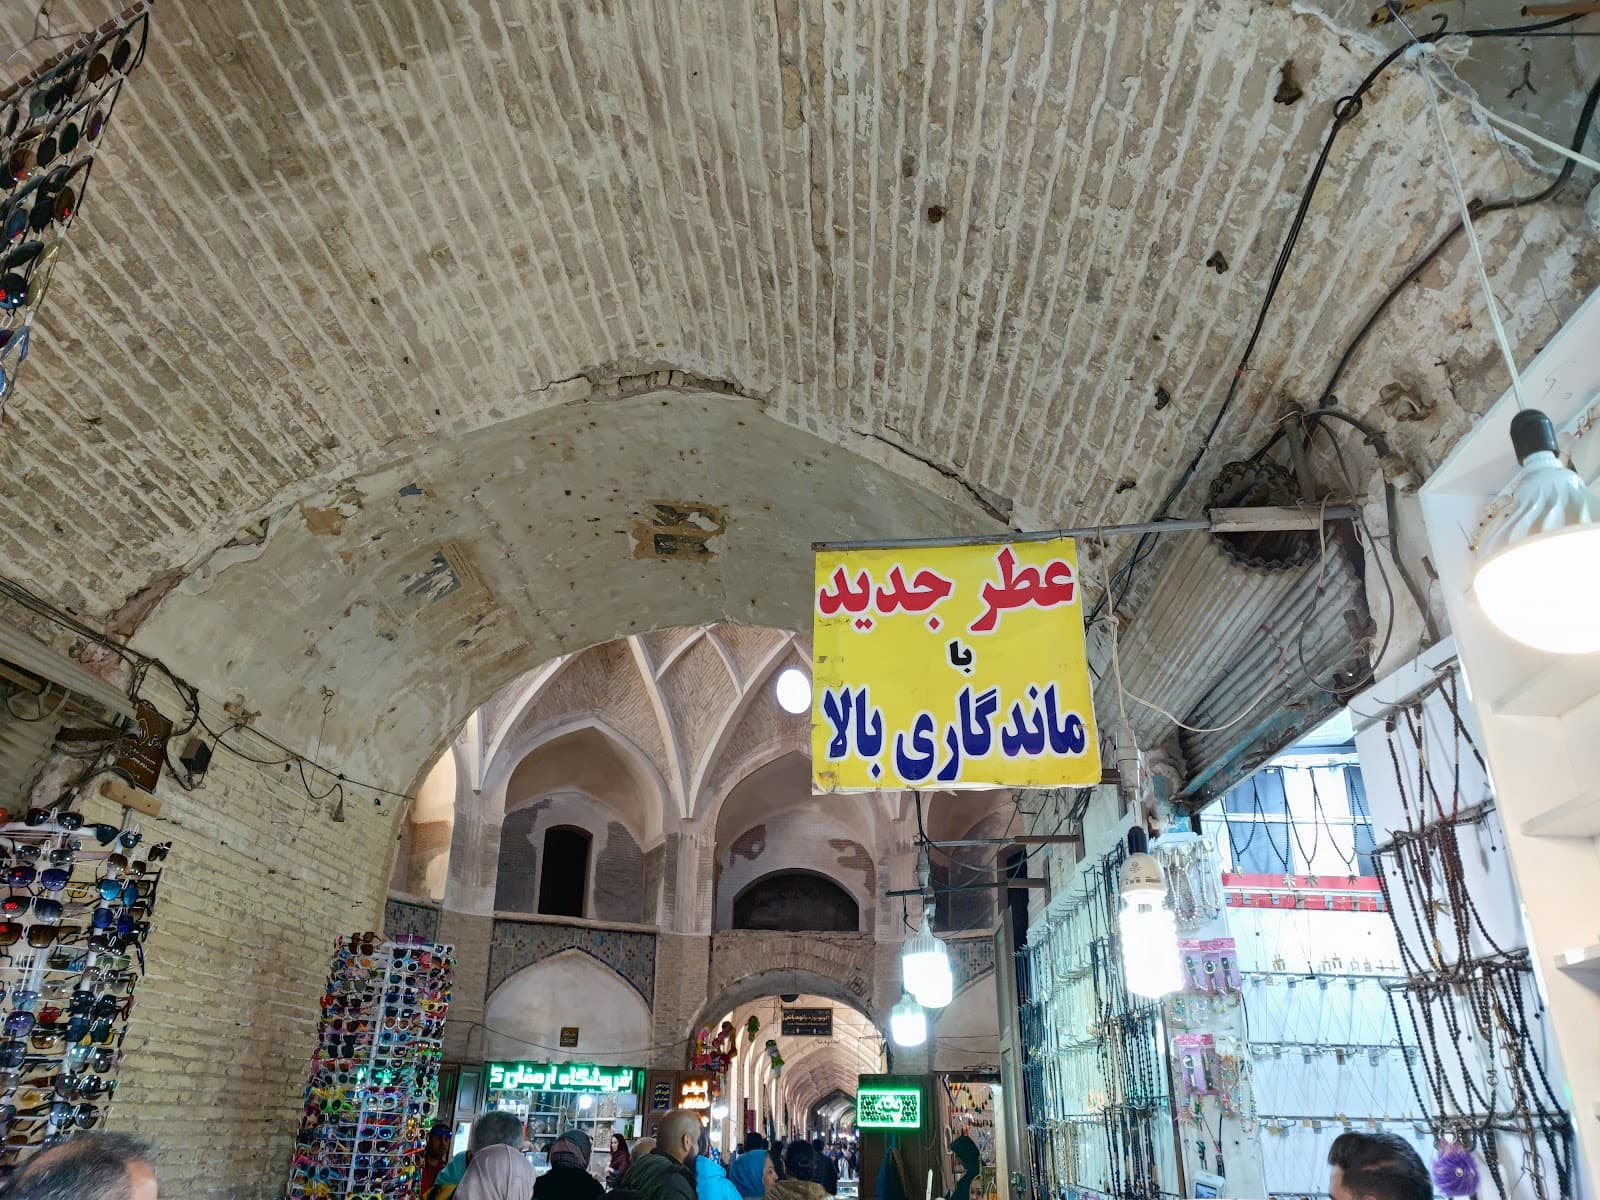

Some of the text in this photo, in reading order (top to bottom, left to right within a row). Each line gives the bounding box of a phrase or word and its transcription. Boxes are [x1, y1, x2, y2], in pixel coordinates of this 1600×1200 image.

[819, 547, 1074, 631] عطر جدید
[950, 641, 972, 674] با
[824, 684, 1085, 781] ماندگاری بالا
[559, 1066, 631, 1092] فروشگاه
